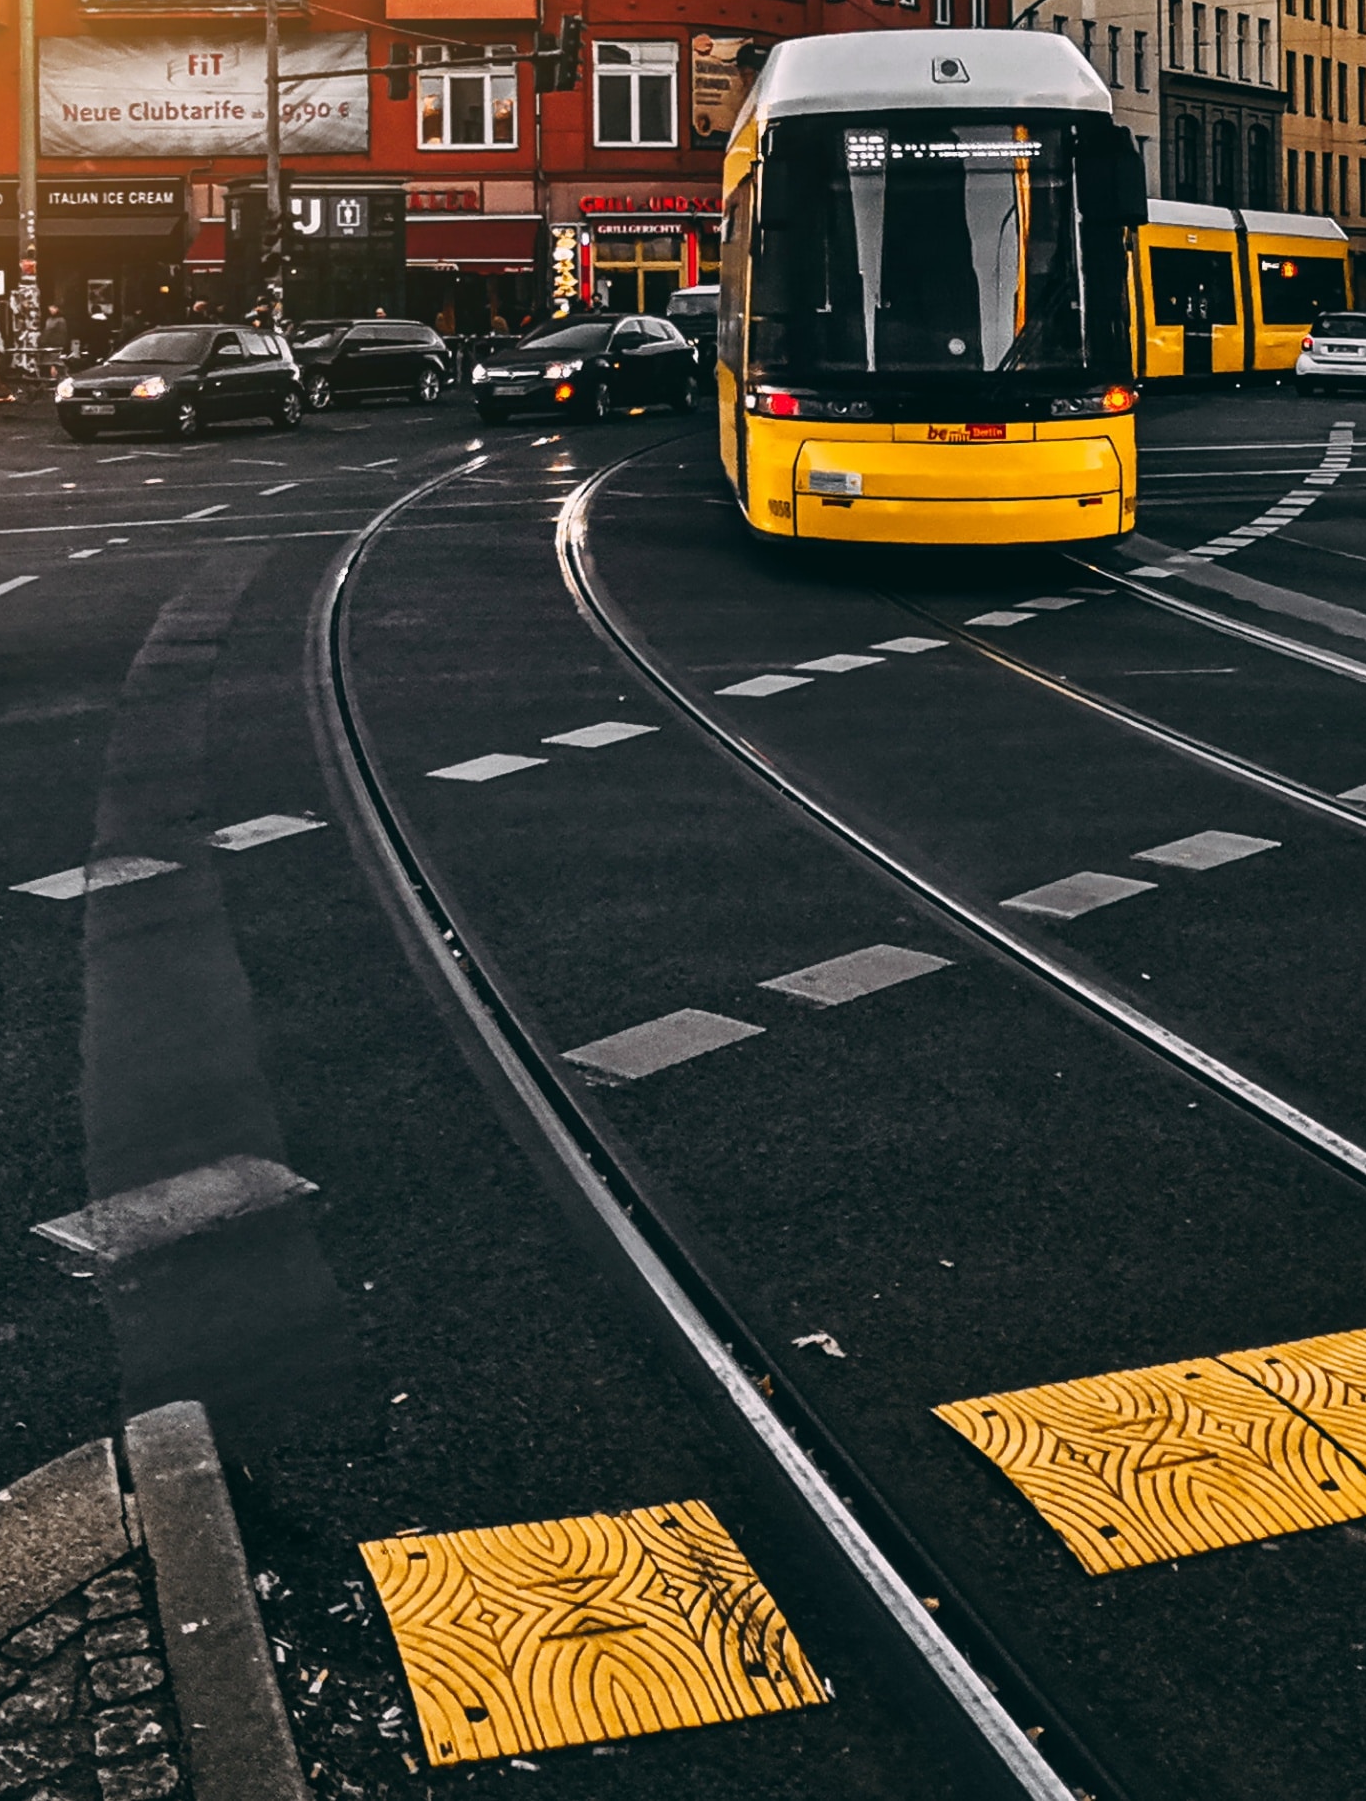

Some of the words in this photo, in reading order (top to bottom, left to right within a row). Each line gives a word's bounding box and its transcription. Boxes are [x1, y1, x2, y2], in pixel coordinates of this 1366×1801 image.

[188, 54, 224, 76] FiT
[62, 104, 121, 122] Neue
[128, 102, 245, 122] Clubtarife
[251, 111, 265, 120] ab
[337, 103, 351, 118] €
[49, 192, 98, 204] ITALIAN
[103, 192, 124, 204] ICE
[129, 192, 173, 204] CREAM
[579, 195, 636, 213] GRILL
[649, 196, 688, 212] UND
